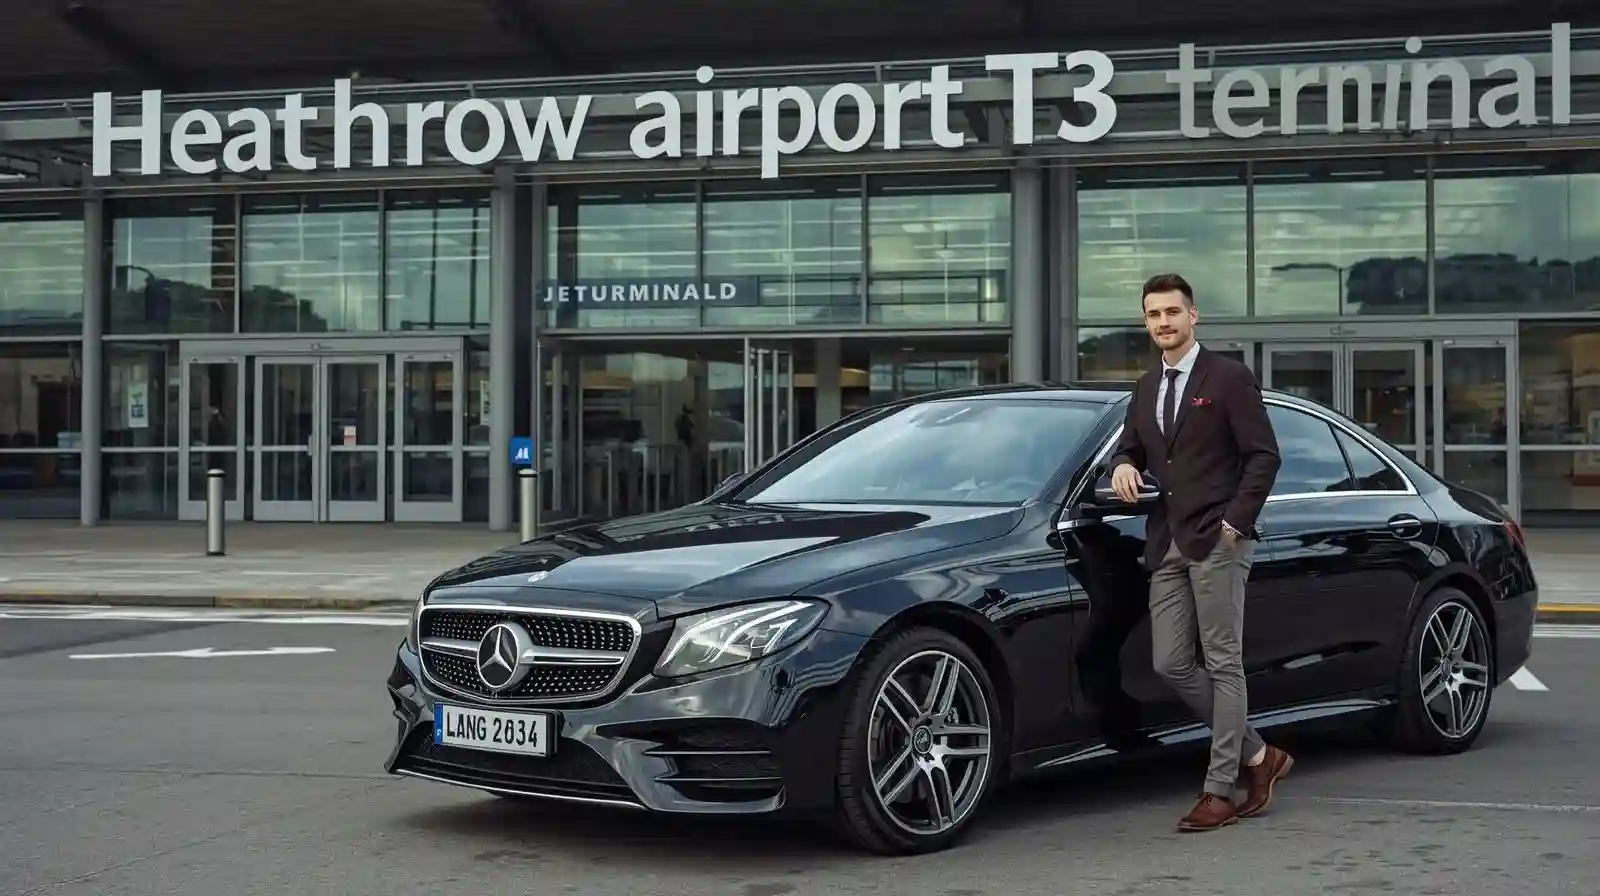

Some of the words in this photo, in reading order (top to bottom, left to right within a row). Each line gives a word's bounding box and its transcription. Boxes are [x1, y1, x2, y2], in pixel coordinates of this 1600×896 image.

[92, 78, 592, 176] Heathrow
[629, 64, 964, 178] airport
[985, 49, 1118, 144] T3
[543, 282, 736, 302] JETURMINALD
[446, 711, 487, 741] LANG
